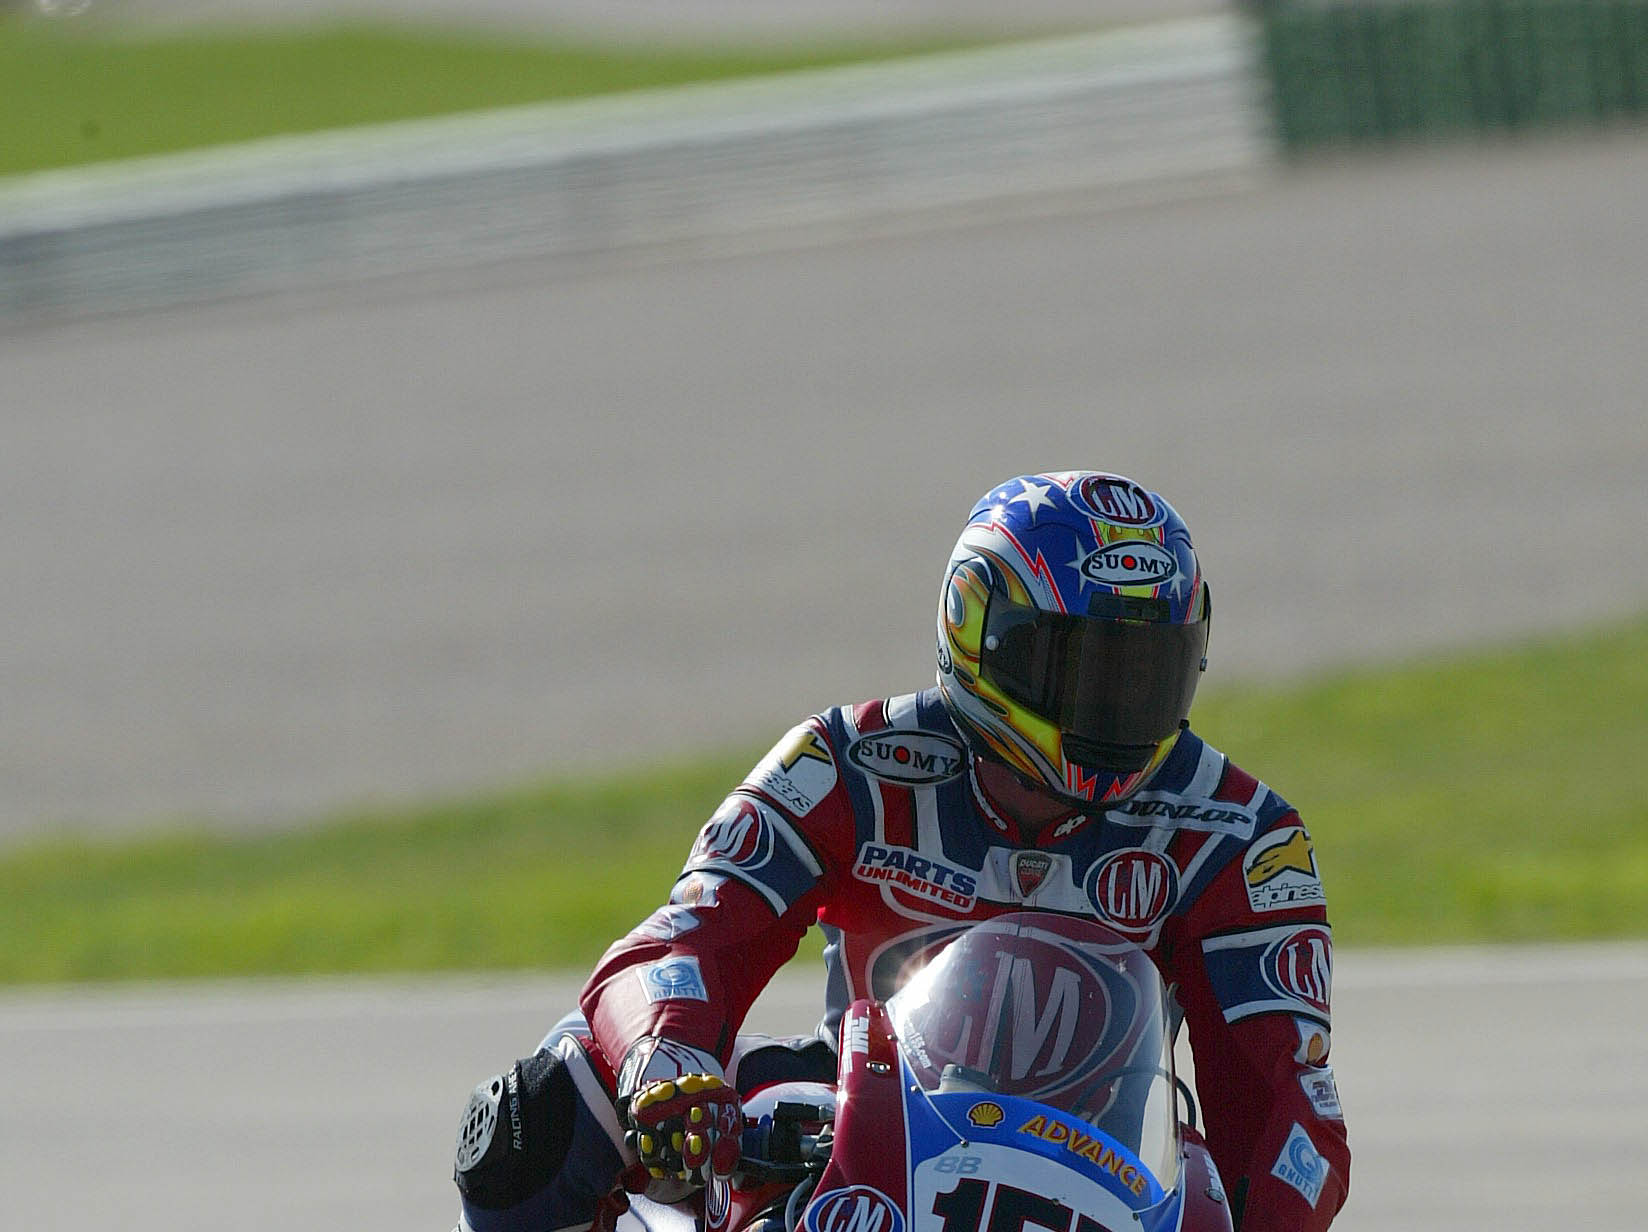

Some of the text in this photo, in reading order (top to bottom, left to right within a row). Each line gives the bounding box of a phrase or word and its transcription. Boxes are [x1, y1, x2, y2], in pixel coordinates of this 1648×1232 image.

[1091, 553, 1171, 575] SUOMY
[861, 739, 959, 776] SUOMY
[857, 864, 976, 909] UNLIMITED
[861, 845, 977, 896] PARTS
[1017, 1114, 1148, 1198] ADVANCE
